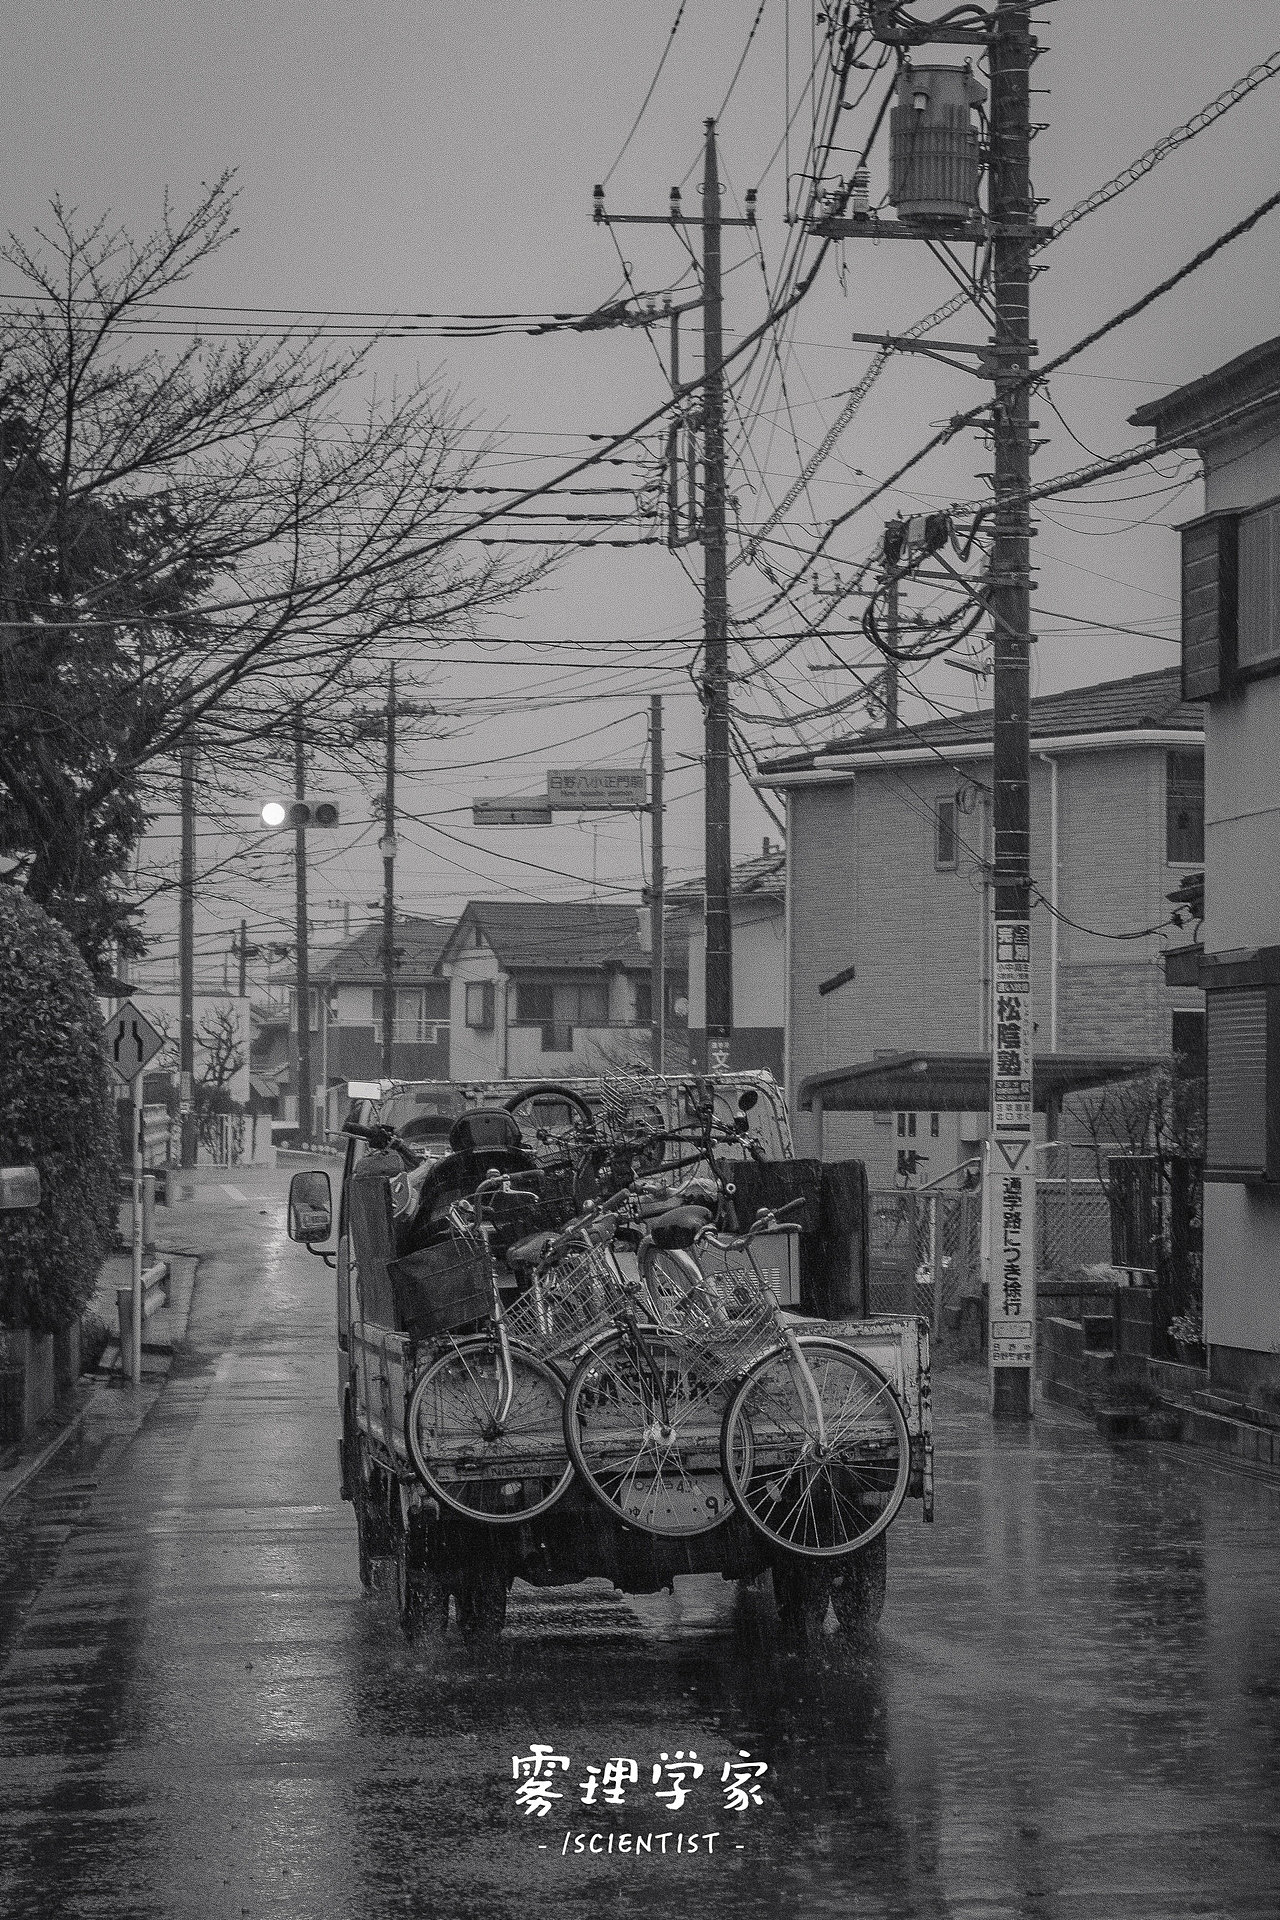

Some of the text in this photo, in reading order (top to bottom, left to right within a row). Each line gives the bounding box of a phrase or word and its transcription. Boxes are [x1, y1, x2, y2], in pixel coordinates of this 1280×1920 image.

[550, 775, 643, 789] 日野八小正門前
[997, 995, 1021, 1076] 松陰塾
[1002, 1176, 1022, 1316] 通学路につき徐行
